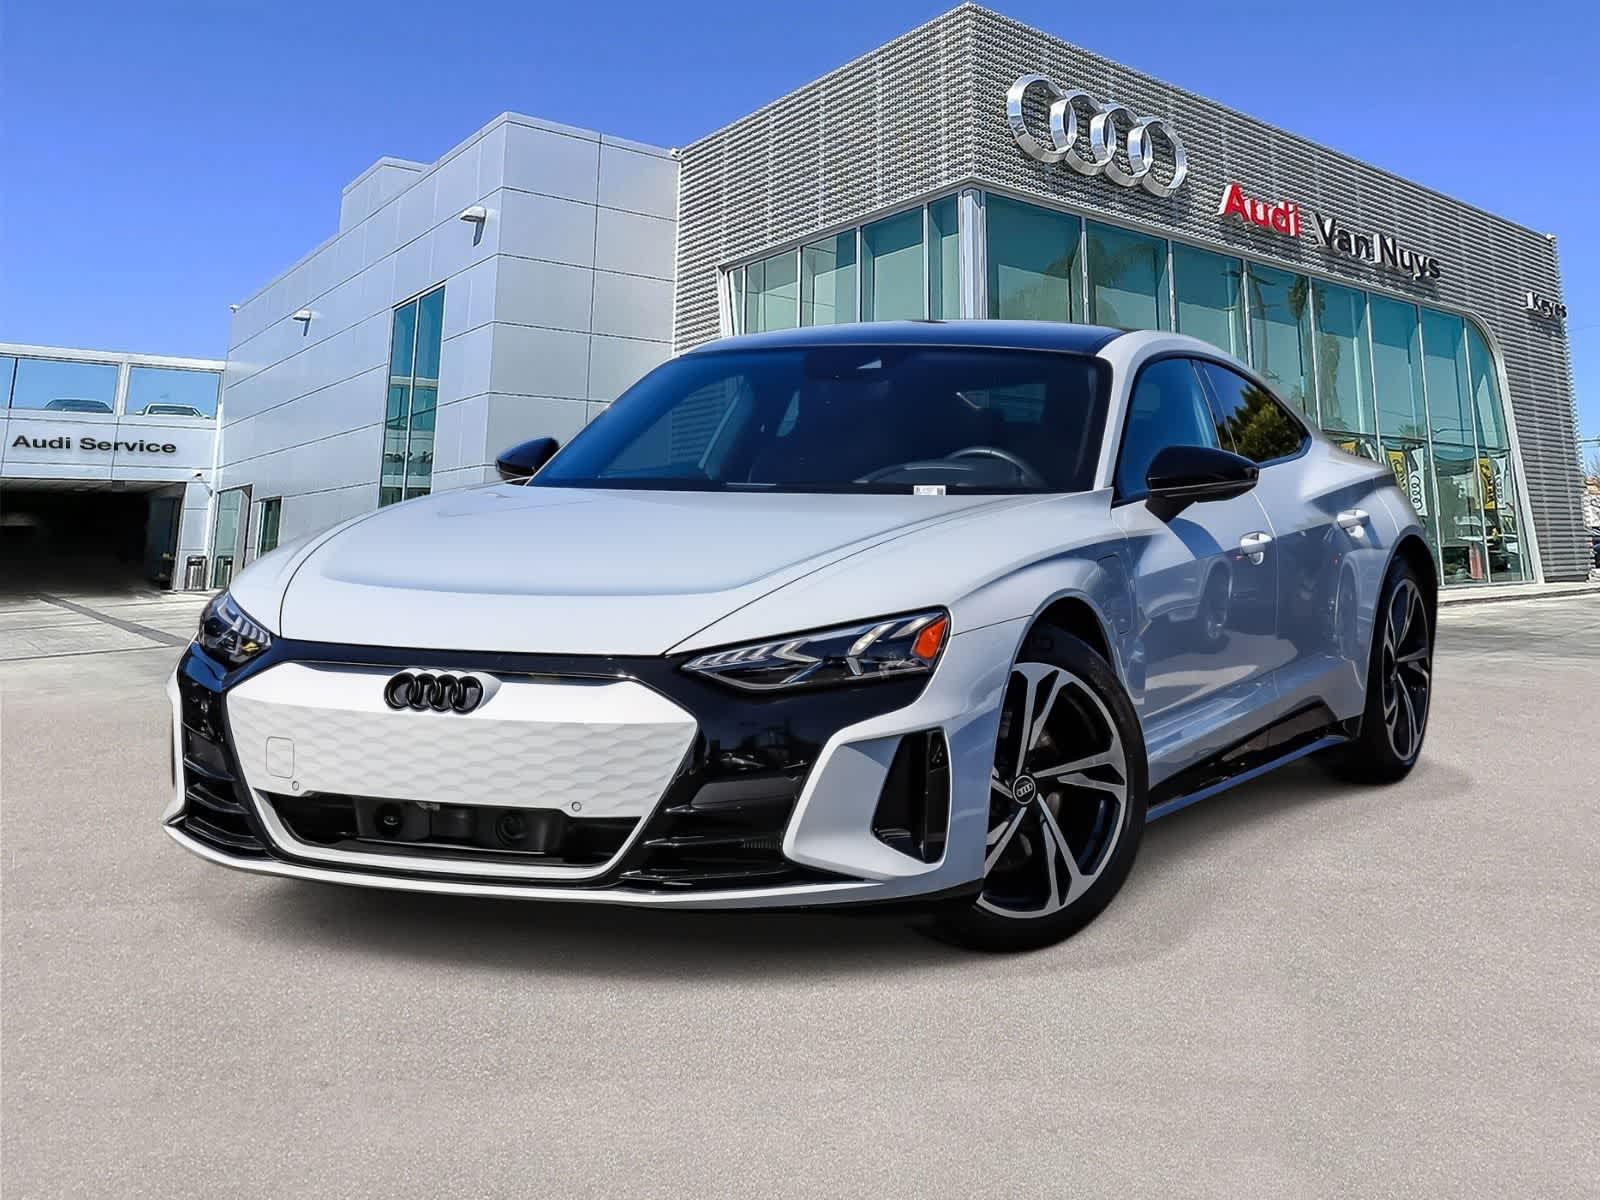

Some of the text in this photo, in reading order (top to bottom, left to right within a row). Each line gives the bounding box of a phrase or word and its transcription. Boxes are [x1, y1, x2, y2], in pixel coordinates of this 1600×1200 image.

[1218, 183, 1441, 280] Audi Van Nuys
[1526, 292, 1567, 318] Keyes
[12, 435, 177, 454] Audi Service
